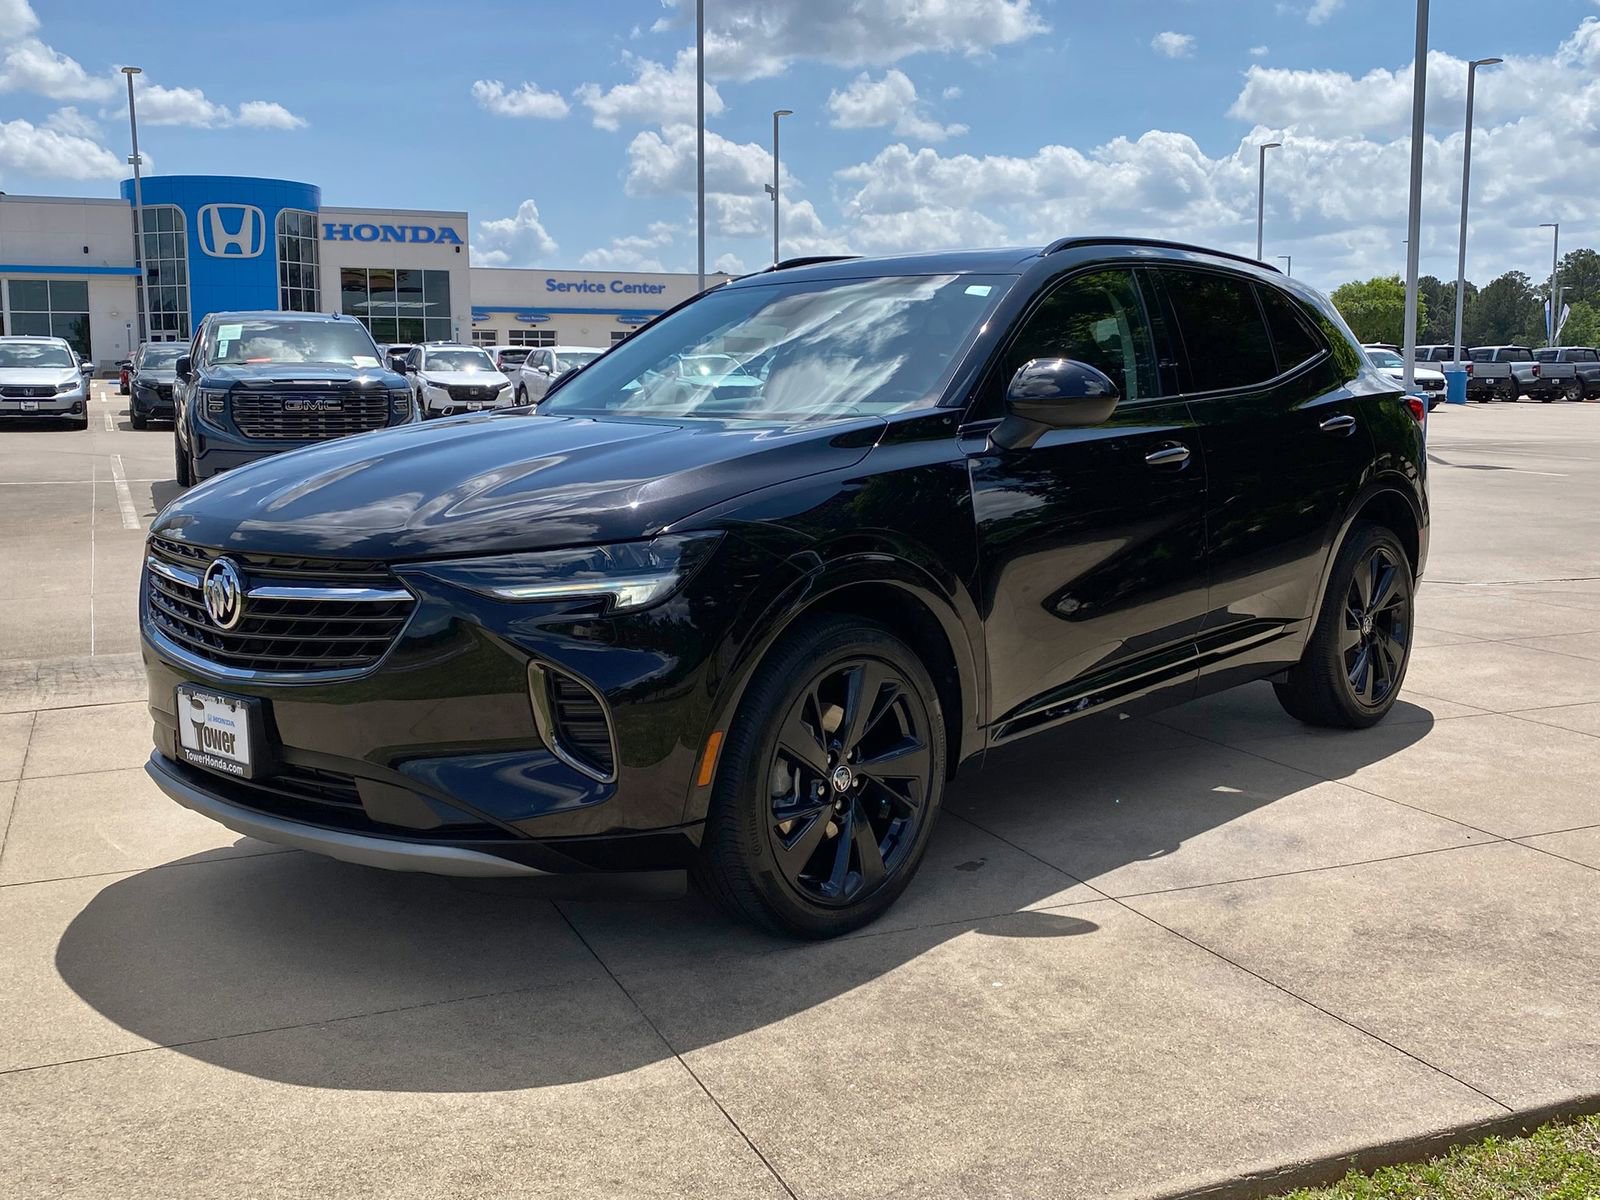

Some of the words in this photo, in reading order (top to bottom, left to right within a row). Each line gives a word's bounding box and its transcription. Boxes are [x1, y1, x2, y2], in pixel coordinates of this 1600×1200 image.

[322, 223, 464, 245] HONDA
[545, 278, 606, 293] Service
[609, 280, 666, 295] Center
[285, 399, 343, 412] GMC
[212, 715, 235, 728] HONDA
[191, 718, 236, 755] Tower
[184, 749, 244, 777] TowerHonda.com
